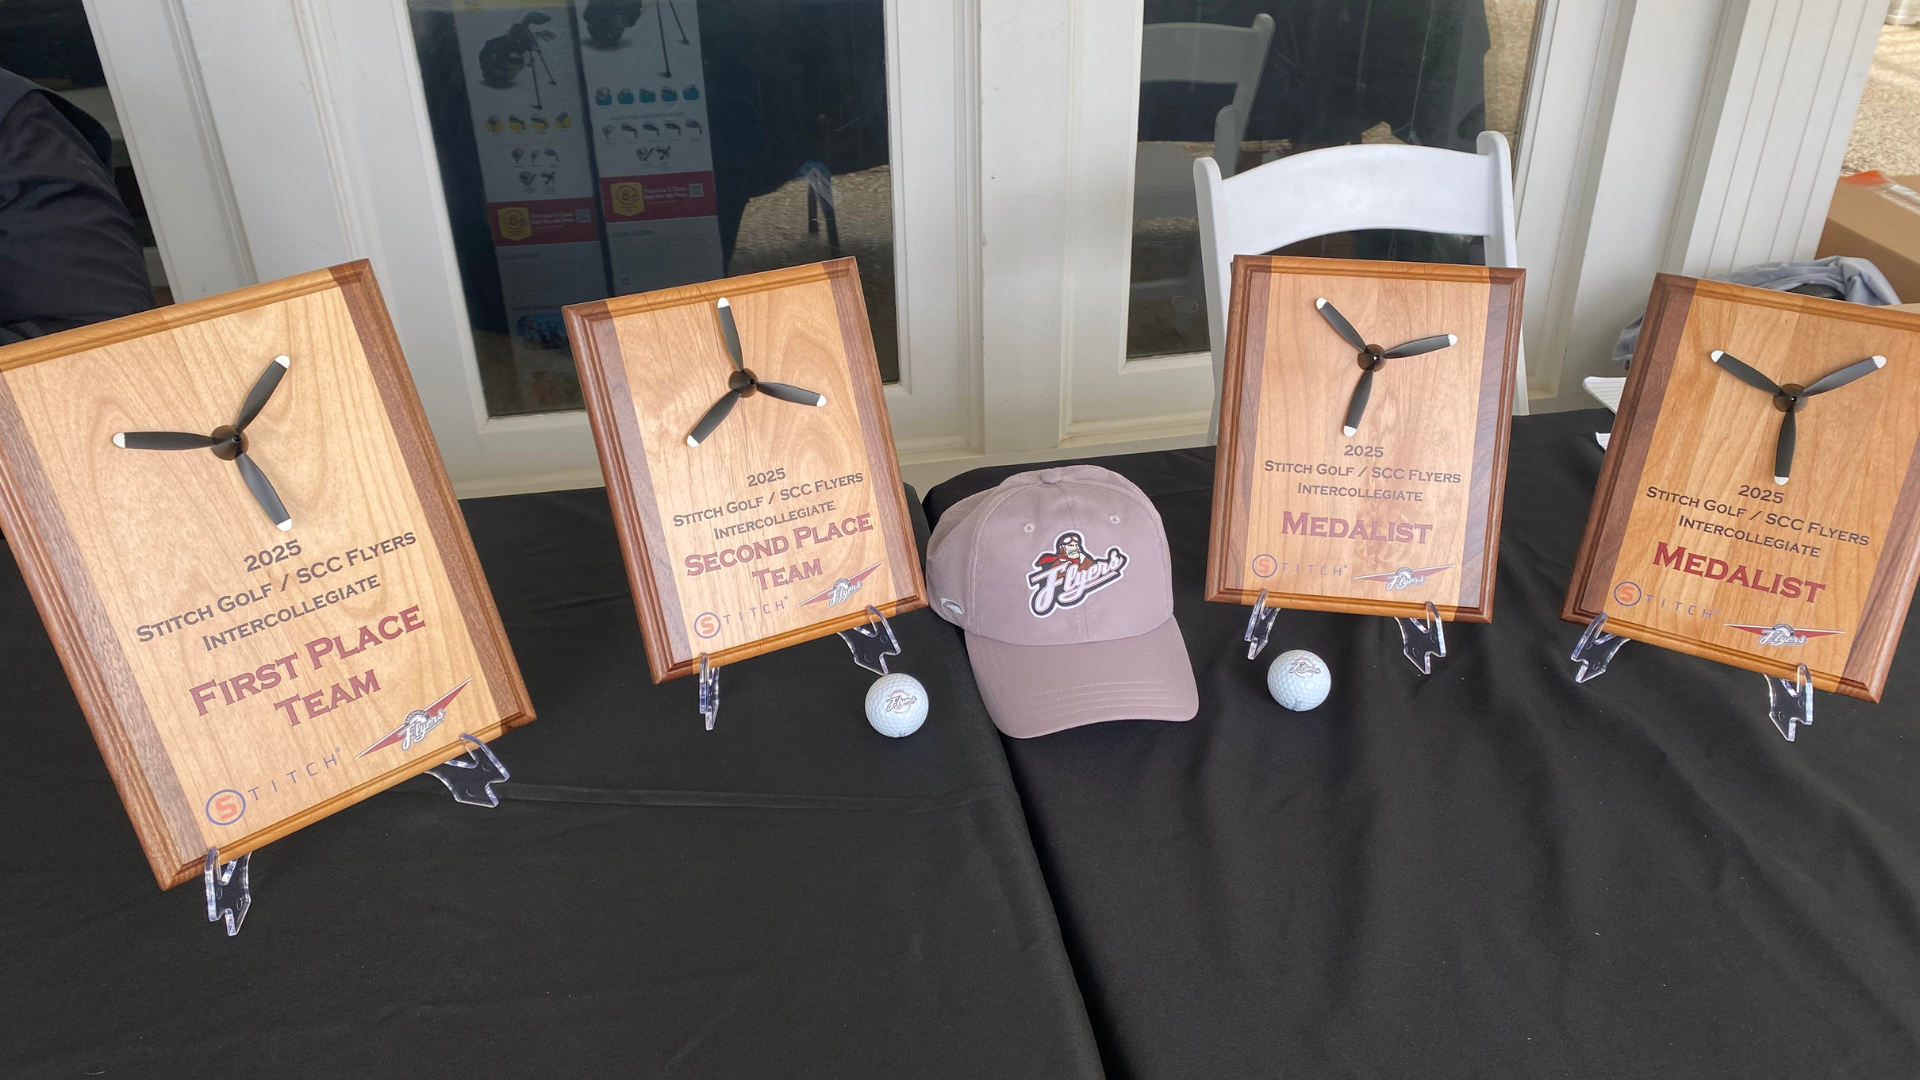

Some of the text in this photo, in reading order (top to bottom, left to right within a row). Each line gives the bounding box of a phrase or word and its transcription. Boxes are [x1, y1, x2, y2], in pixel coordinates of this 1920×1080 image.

[1344, 445, 1384, 458] 2025
[747, 468, 786, 487] 2025
[1264, 460, 1313, 474] STITCH
[1316, 463, 1355, 477] GOLF
[1371, 467, 1405, 481] SCC
[1408, 469, 1462, 484] FLYERS
[673, 506, 724, 527] STITCH
[726, 493, 764, 514] GOLF
[780, 484, 812, 501] SCC
[814, 473, 864, 493] FLYERS
[1298, 483, 1423, 502] INTERCOLLEGIATE
[1738, 484, 1785, 504] 2025
[714, 501, 836, 540] INTERCOLLEGIATE
[1281, 511, 1433, 544] MEDALIST
[1646, 486, 1700, 508] STITCH
[1703, 499, 1747, 518] GOLF
[1765, 513, 1804, 531] SCC
[1807, 522, 1871, 546] FLYERS
[243, 539, 302, 573] 2025
[684, 513, 873, 577] SECOND PLACE
[1678, 515, 1822, 558] INTERCOLLEGIATE
[752, 558, 823, 591] TEAM
[1030, 549, 1125, 614] Flyers
[1252, 553, 1342, 578] STITCH
[1386, 575, 1427, 591] Flyers
[1653, 541, 1826, 603] MEDALIST
[136, 605, 213, 643] STITCH
[217, 583, 272, 613] GOLF
[296, 556, 344, 585] SCC
[345, 532, 416, 567] FLYERS
[828, 580, 863, 608] Flyers
[1613, 581, 1713, 620] STITCH
[202, 575, 381, 651] INTERCOLLEGIATE
[694, 600, 785, 639] STITCH
[1759, 629, 1808, 647] Flyers
[189, 605, 426, 716] FIRST PLACE
[273, 669, 381, 727] TEAM
[397, 708, 446, 751] Flyers
[205, 751, 338, 826] STITCH
